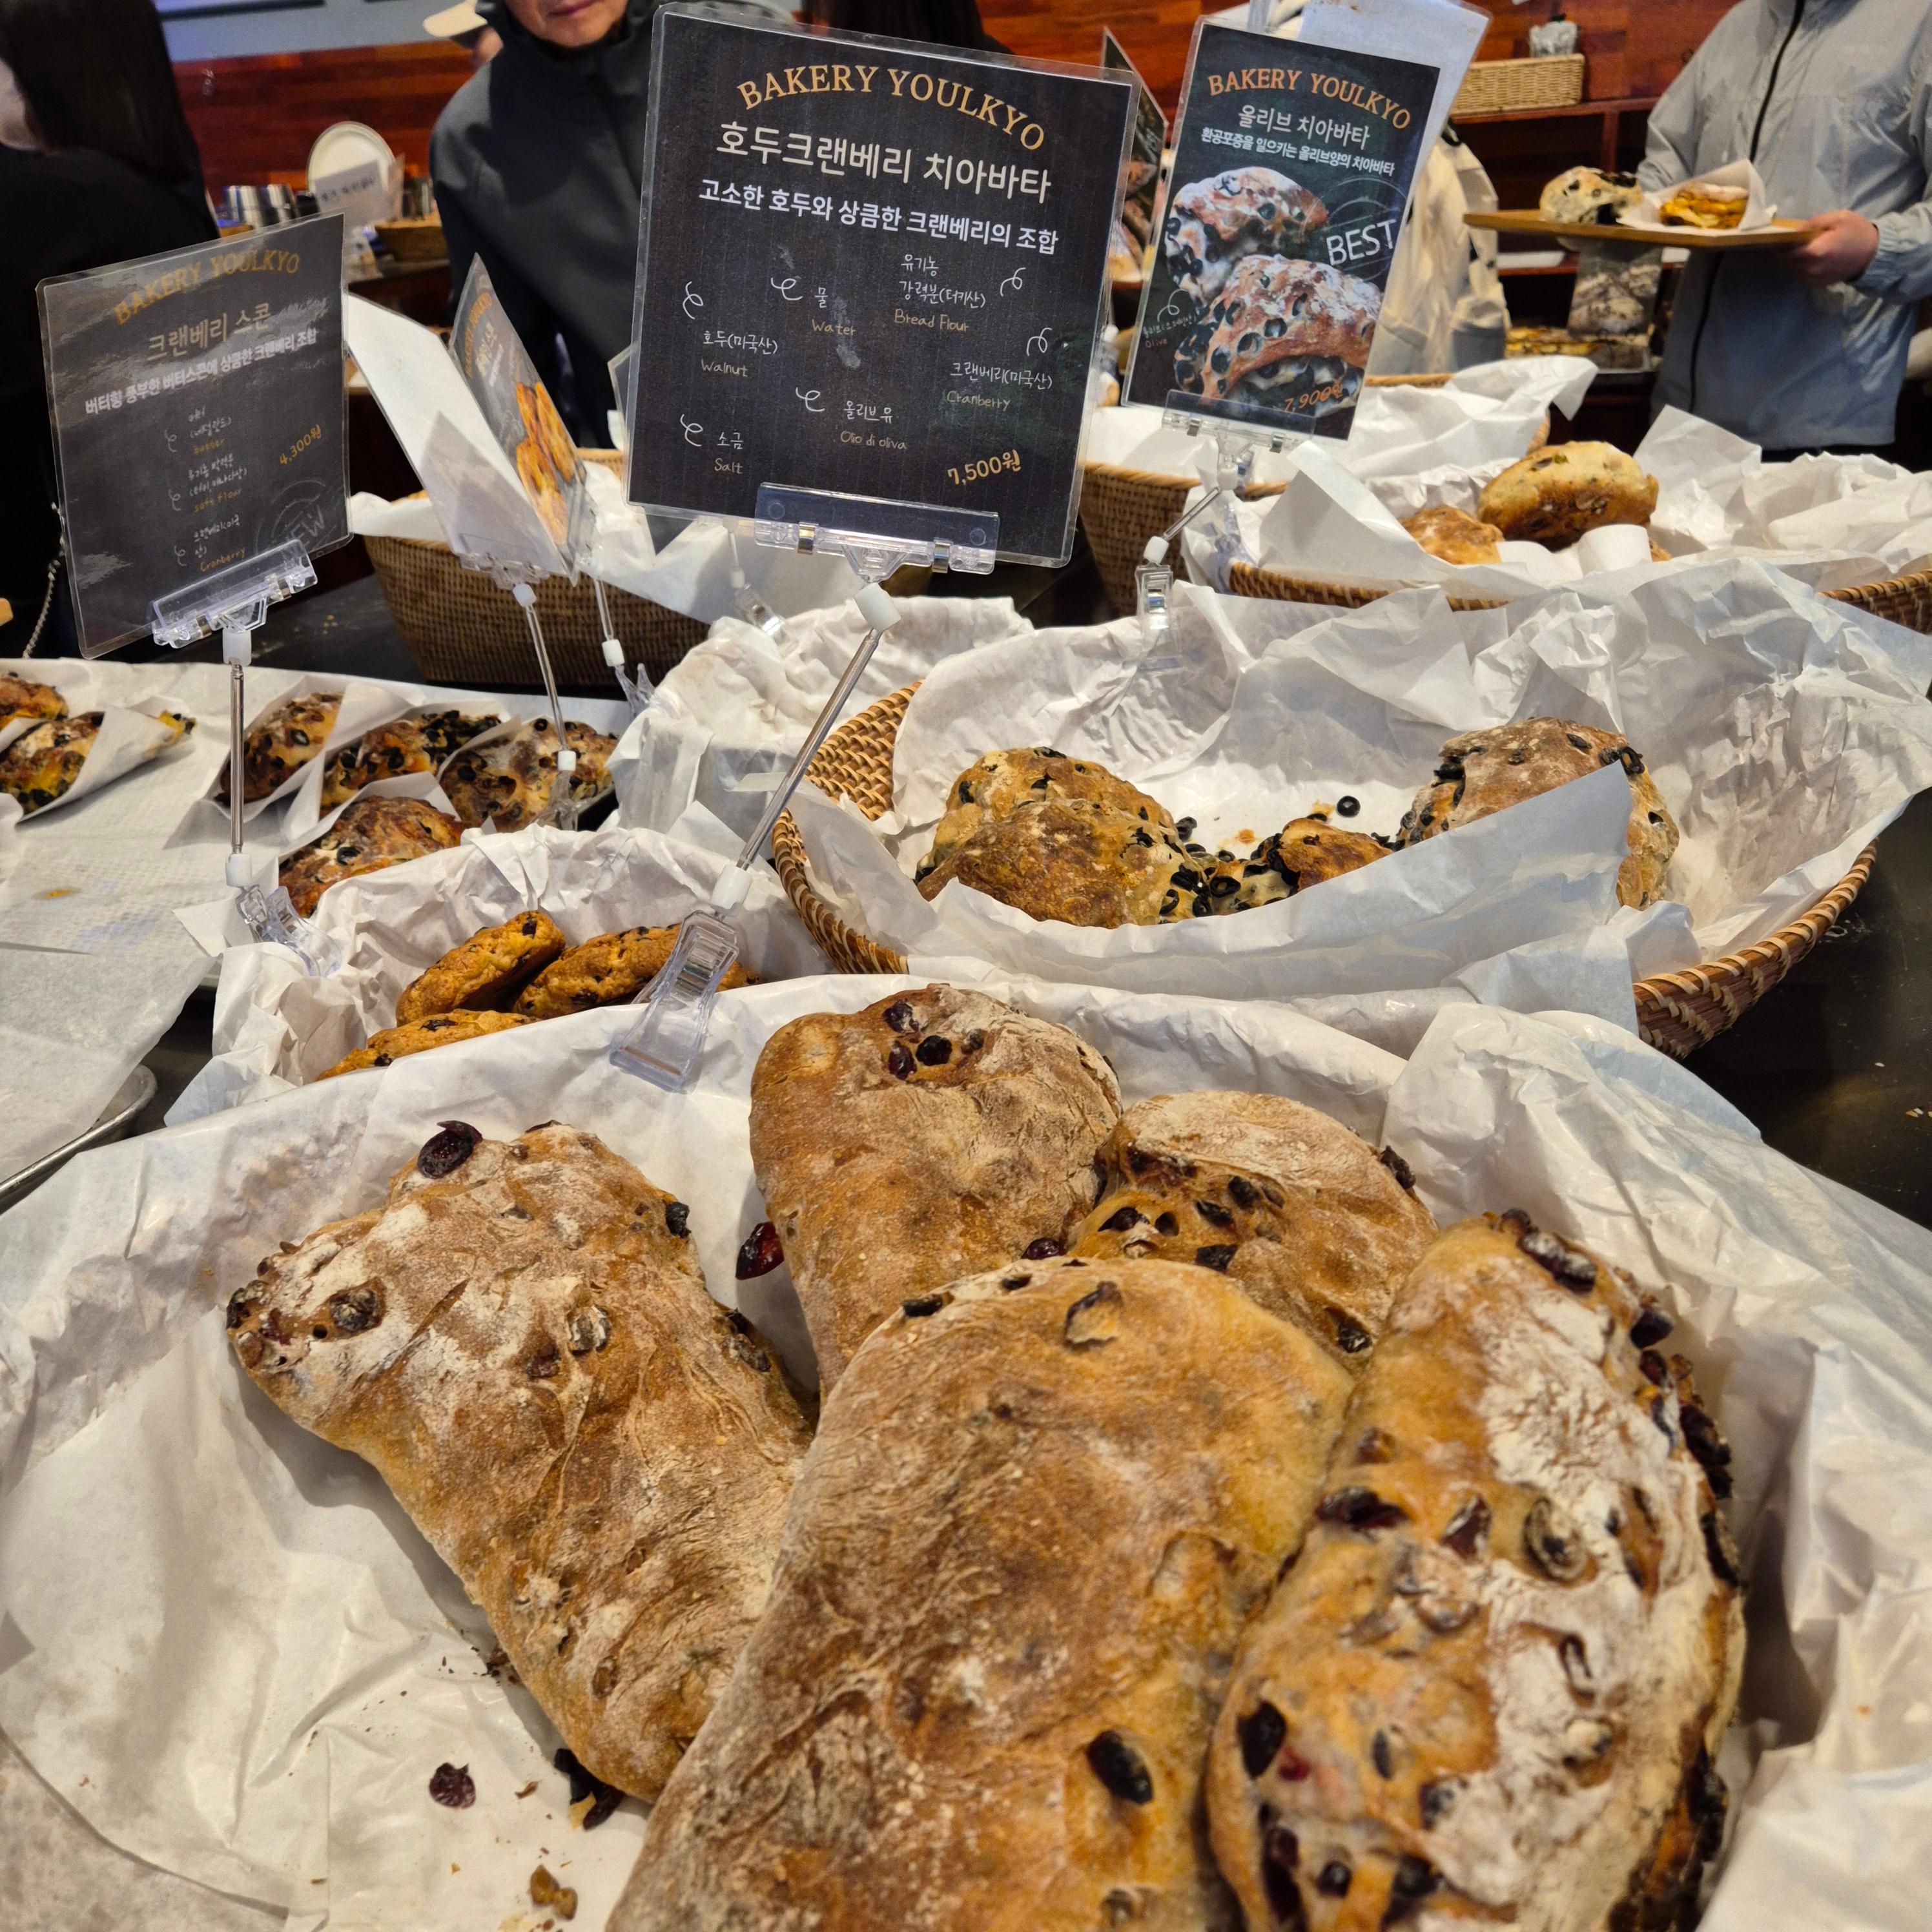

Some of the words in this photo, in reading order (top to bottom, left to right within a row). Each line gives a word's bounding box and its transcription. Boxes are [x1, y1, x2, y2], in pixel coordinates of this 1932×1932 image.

[737, 64, 879, 110] BAKERY
[887, 69, 1045, 151] YOULKYO
[1208, 68, 1302, 96] BAKERY
[1310, 72, 1412, 130] YOULKYO
[1238, 104, 1291, 133] 올리브
[1297, 116, 1371, 150] 치아바타
[715, 121, 912, 185] 호두크랜베리
[923, 151, 1053, 204] 치아바타
[1256, 138, 1298, 159] 일으키는
[1351, 156, 1395, 177] 치아바타
[699, 179, 765, 211] 고소한
[768, 189, 834, 221] 호두와
[838, 200, 903, 232] 상큼한
[906, 211, 1012, 248] 크랜베리의
[1016, 227, 1059, 255] 조합
[1326, 218, 1397, 266] BEST
[901, 254, 940, 277] 유기농
[113, 261, 201, 325] BAKERY
[210, 249, 301, 278] YOULKYO
[814, 287, 828, 309] 물
[898, 280, 986, 309] 강력분(터키산)
[147, 312, 228, 362] 크랜베리
[233, 302, 271, 334] 스콘
[812, 319, 856, 336] Water
[894, 307, 935, 328] Bread
[940, 314, 969, 332] Flour
[703, 330, 778, 355] 호두(미국산)
[85, 389, 123, 415] 버터향
[220, 347, 253, 373] 상큼한
[254, 333, 295, 362] 크랜베리
[296, 327, 319, 349] 조합
[701, 358, 748, 377] Walnut
[950, 362, 1053, 390] 크랜베리(미국산)
[947, 390, 1011, 411] Cranberry
[717, 431, 744, 450] 소금
[840, 430, 863, 444] Olio
[866, 434, 876, 446] di
[879, 437, 907, 450] oliva
[714, 457, 743, 474] Salt
[947, 449, 1022, 486] 7,500원
